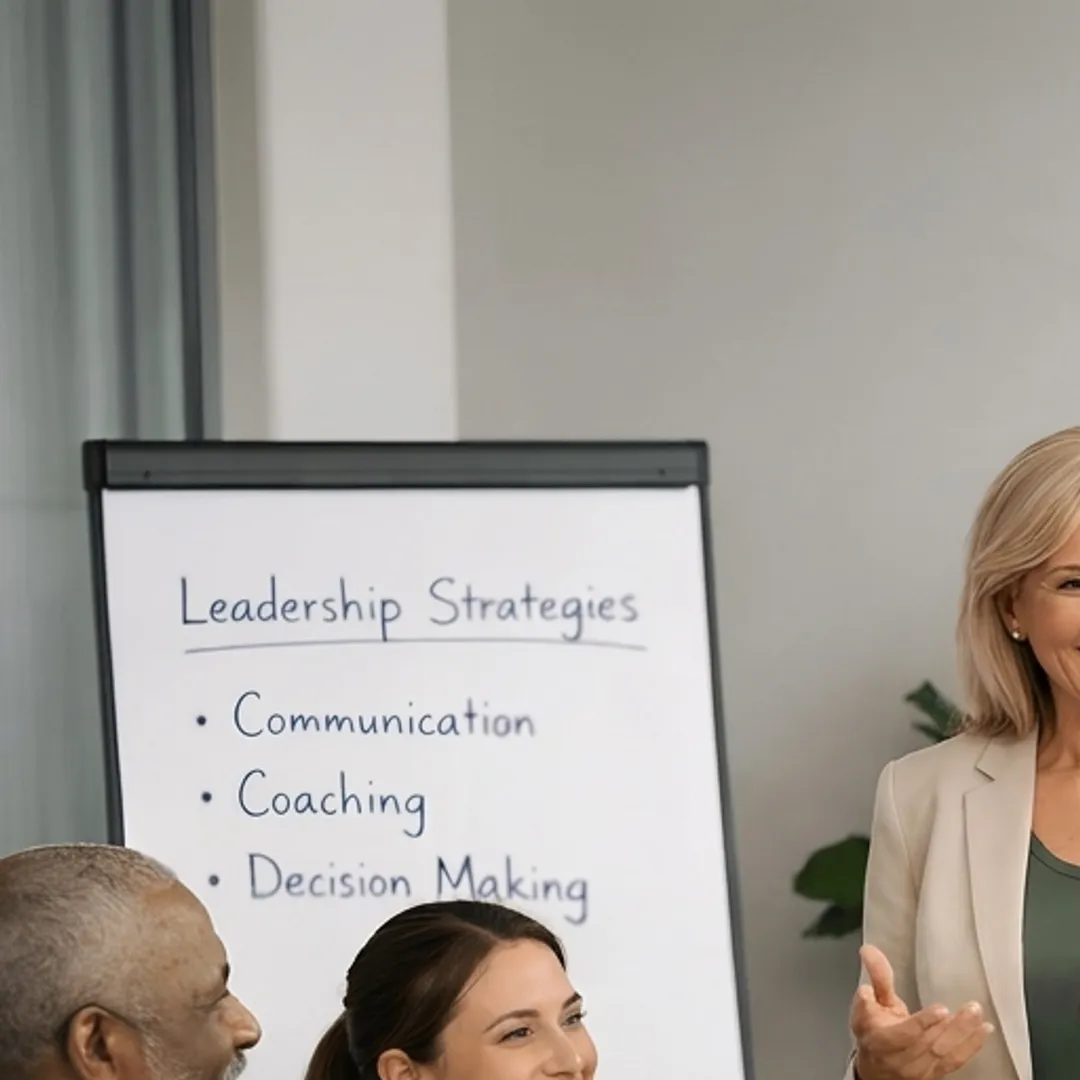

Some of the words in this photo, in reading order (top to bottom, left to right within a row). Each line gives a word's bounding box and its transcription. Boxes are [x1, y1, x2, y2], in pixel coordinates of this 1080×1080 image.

[181, 575, 402, 642] Leadership
[428, 576, 640, 642] Strategies
[232, 691, 536, 738] Communication
[237, 769, 427, 839] Coaching
[248, 852, 412, 900] Decision
[435, 854, 590, 926] Making
